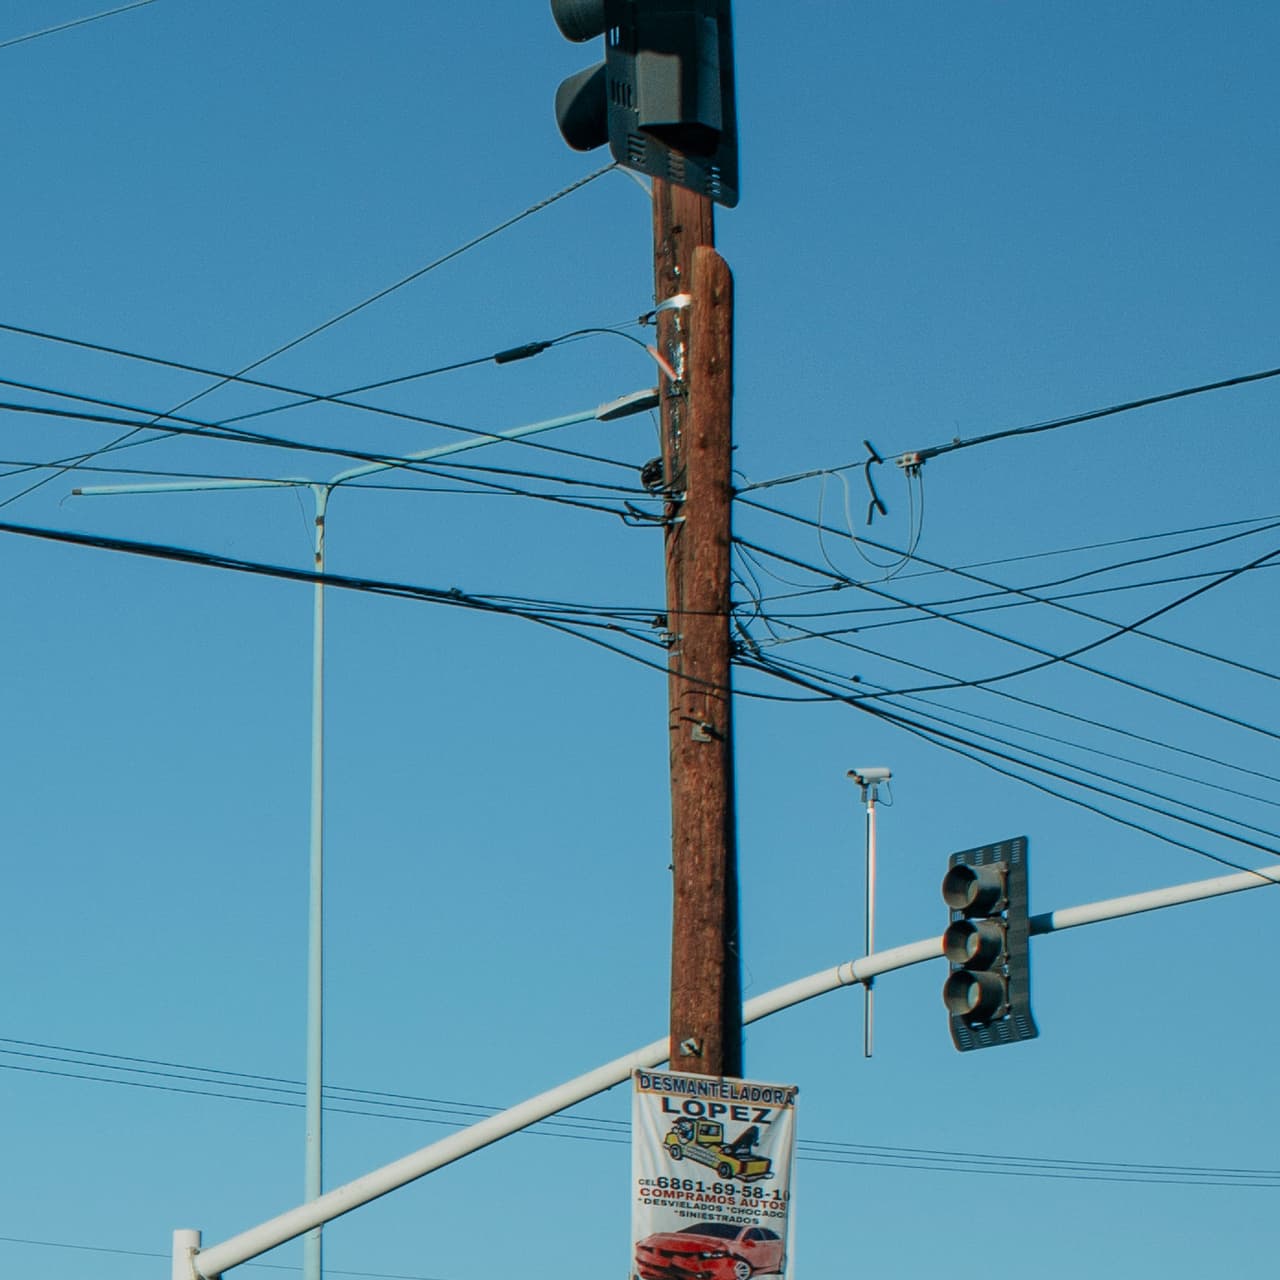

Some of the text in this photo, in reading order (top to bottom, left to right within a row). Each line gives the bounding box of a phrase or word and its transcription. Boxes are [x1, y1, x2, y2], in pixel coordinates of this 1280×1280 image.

[640, 1075, 795, 1106] DESMANTELADORA
[640, 1188, 786, 1211] COMPRAMOS AUTOS
[644, 1198, 722, 1213] DESVIELADOS
[678, 1210, 760, 1225] SINIESTRADOS
